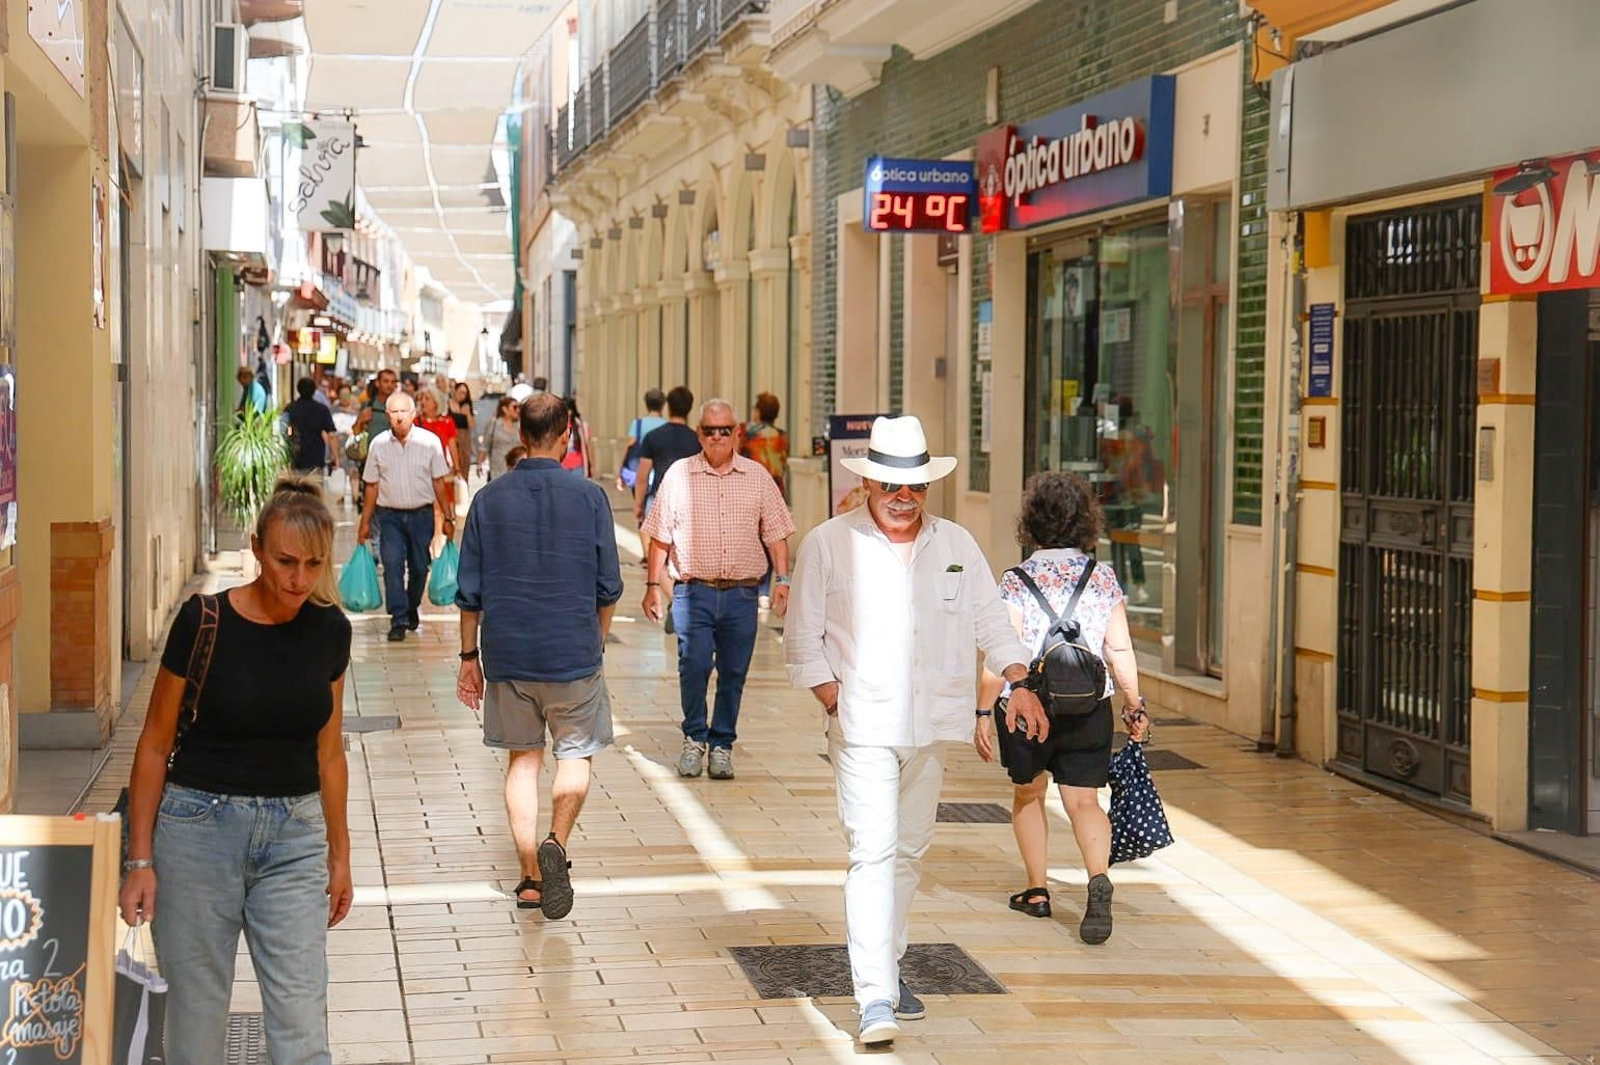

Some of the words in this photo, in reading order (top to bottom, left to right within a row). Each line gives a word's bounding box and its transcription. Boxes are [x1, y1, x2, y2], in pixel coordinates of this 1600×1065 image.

[919, 168, 970, 183] urbano
[1005, 134, 1060, 208] óptica
[1062, 114, 1136, 179] urbano
[871, 194, 914, 229] 24
